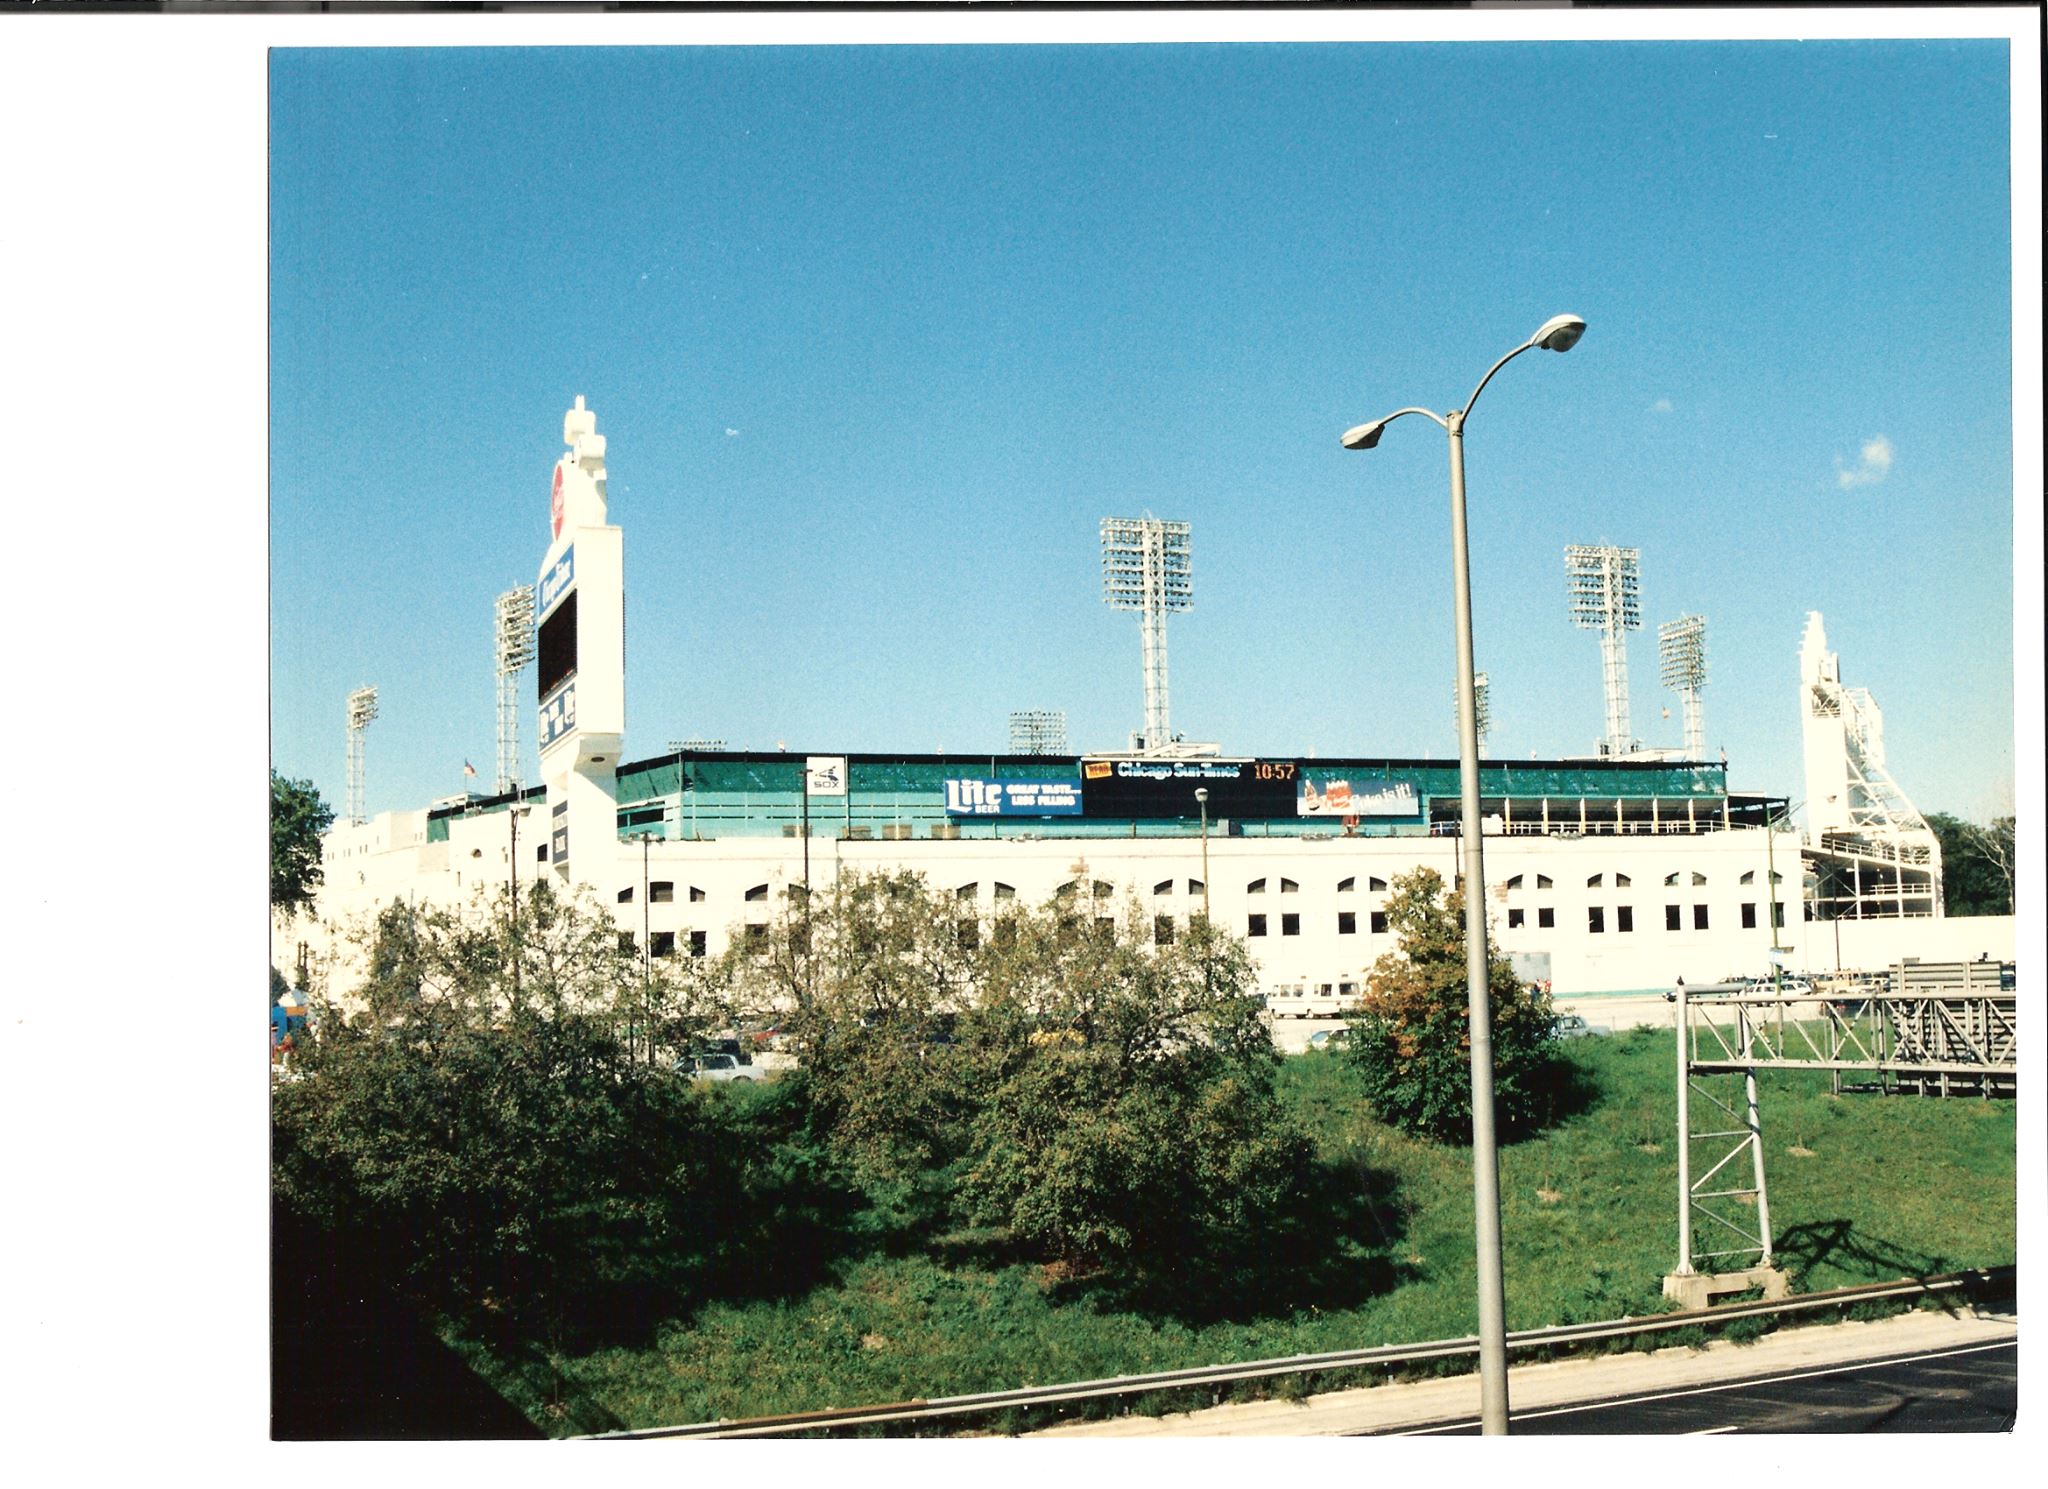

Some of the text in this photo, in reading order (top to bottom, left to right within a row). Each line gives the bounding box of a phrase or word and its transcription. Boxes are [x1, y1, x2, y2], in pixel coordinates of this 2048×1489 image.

[1117, 762, 1240, 780] Chicago Sun-Times
[1254, 763, 1295, 780] 10:57
[814, 781, 839, 789] SOX
[945, 779, 1003, 813] Lite
[1011, 795, 1076, 806] LESS FILLING
[974, 804, 1000, 814] BEER
